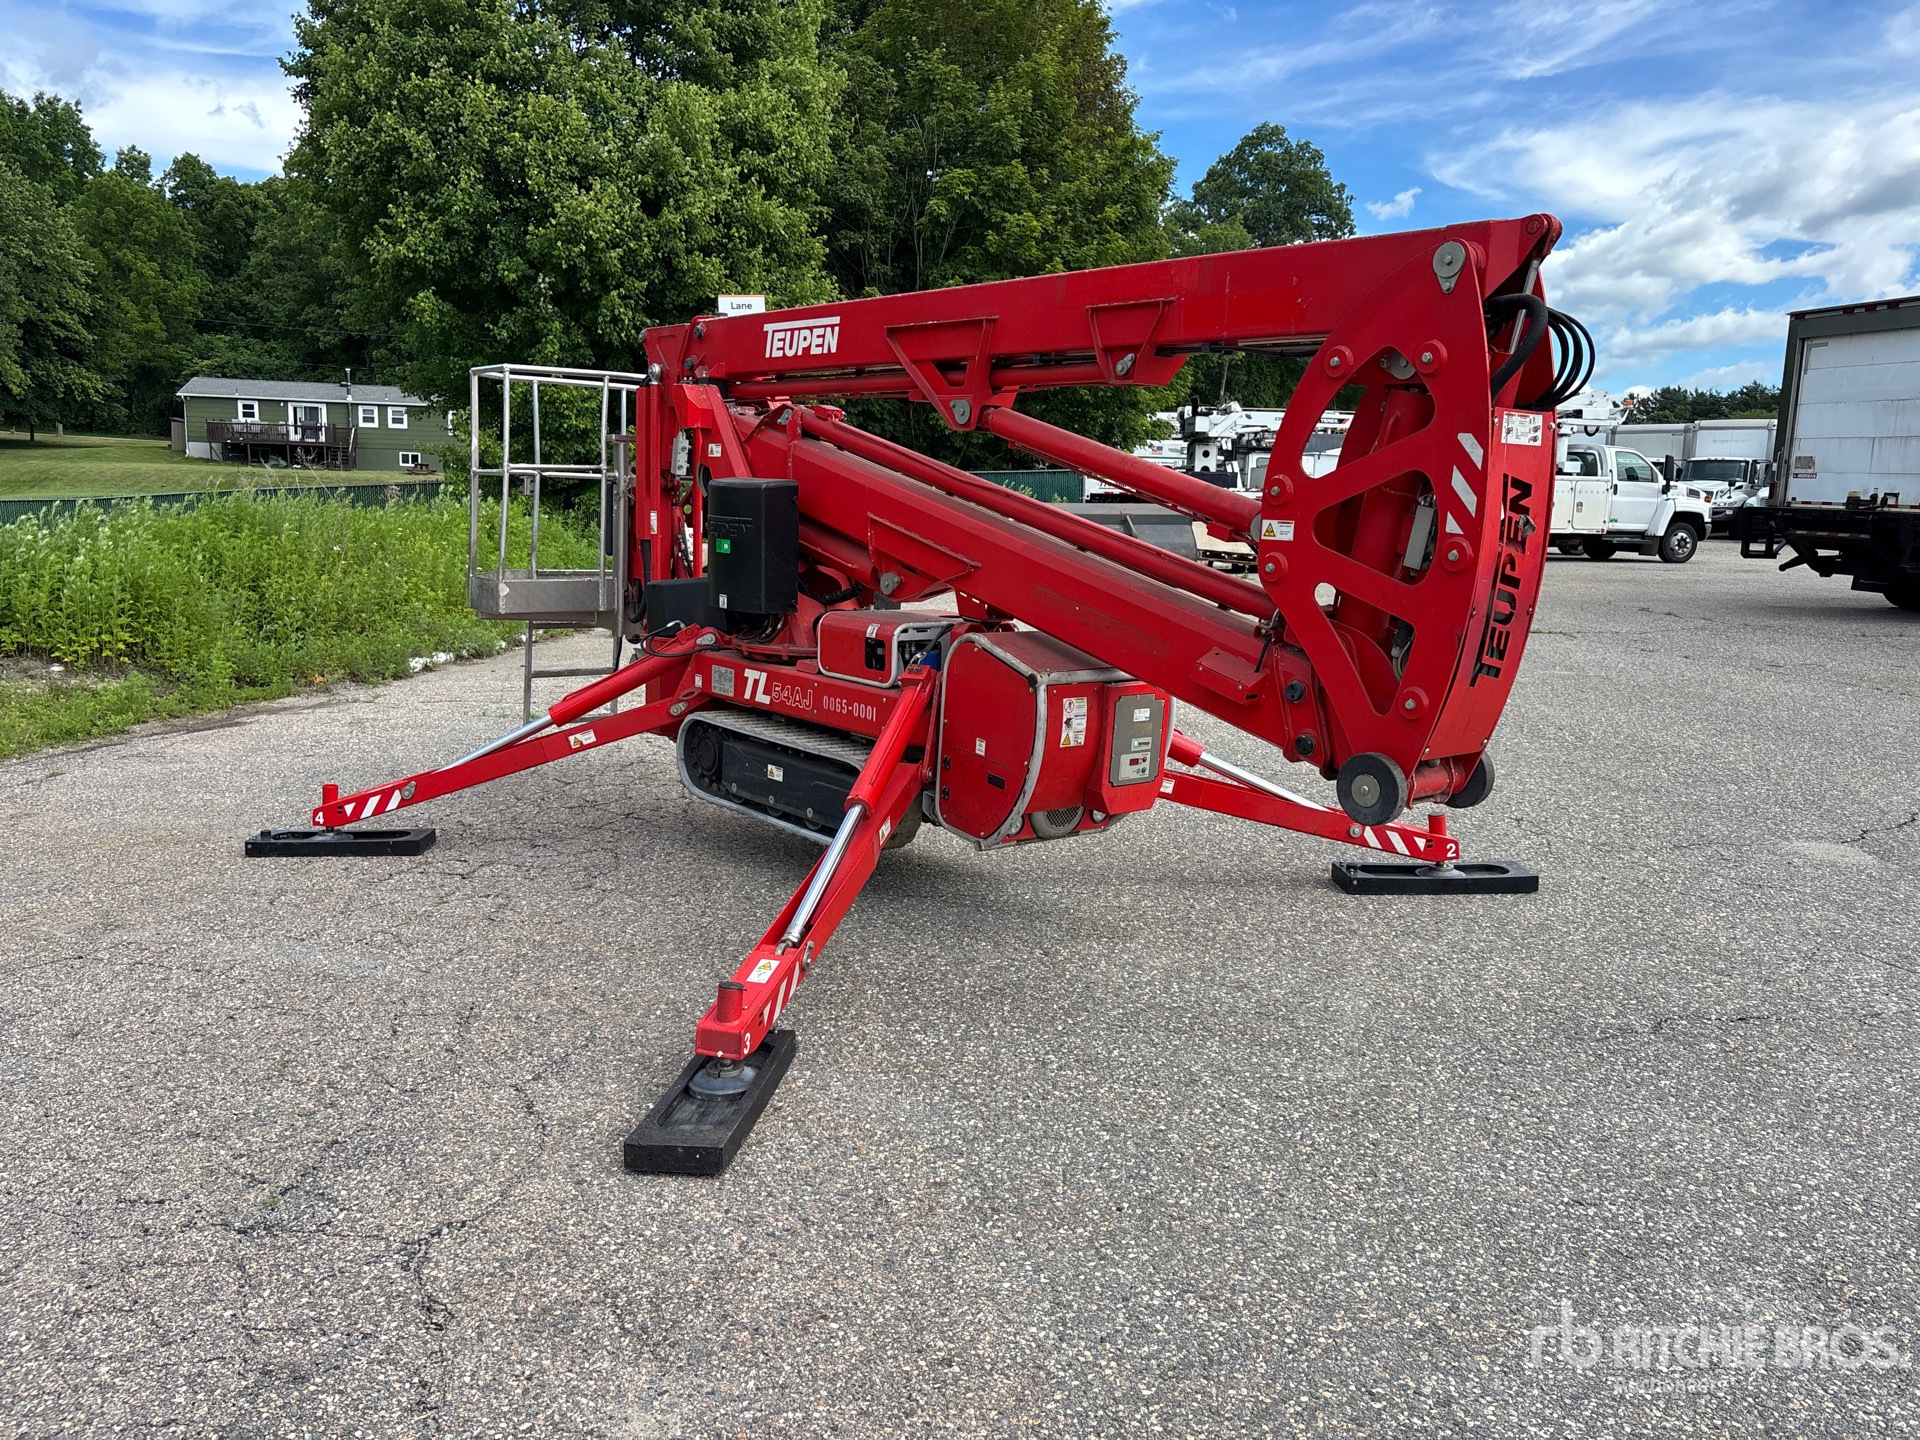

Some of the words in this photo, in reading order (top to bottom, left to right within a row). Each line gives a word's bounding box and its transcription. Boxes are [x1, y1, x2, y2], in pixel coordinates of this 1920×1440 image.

[730, 301, 753, 310] Lane
[763, 316, 841, 358] TEUPEN
[1469, 473, 1533, 688] TEUPEN
[743, 668, 771, 705] TL
[771, 682, 813, 710] 54AJ
[822, 695, 877, 722] 0065-0001
[315, 811, 325, 825] 4
[1446, 843, 1457, 857] 2
[743, 1032, 751, 1055] 3
